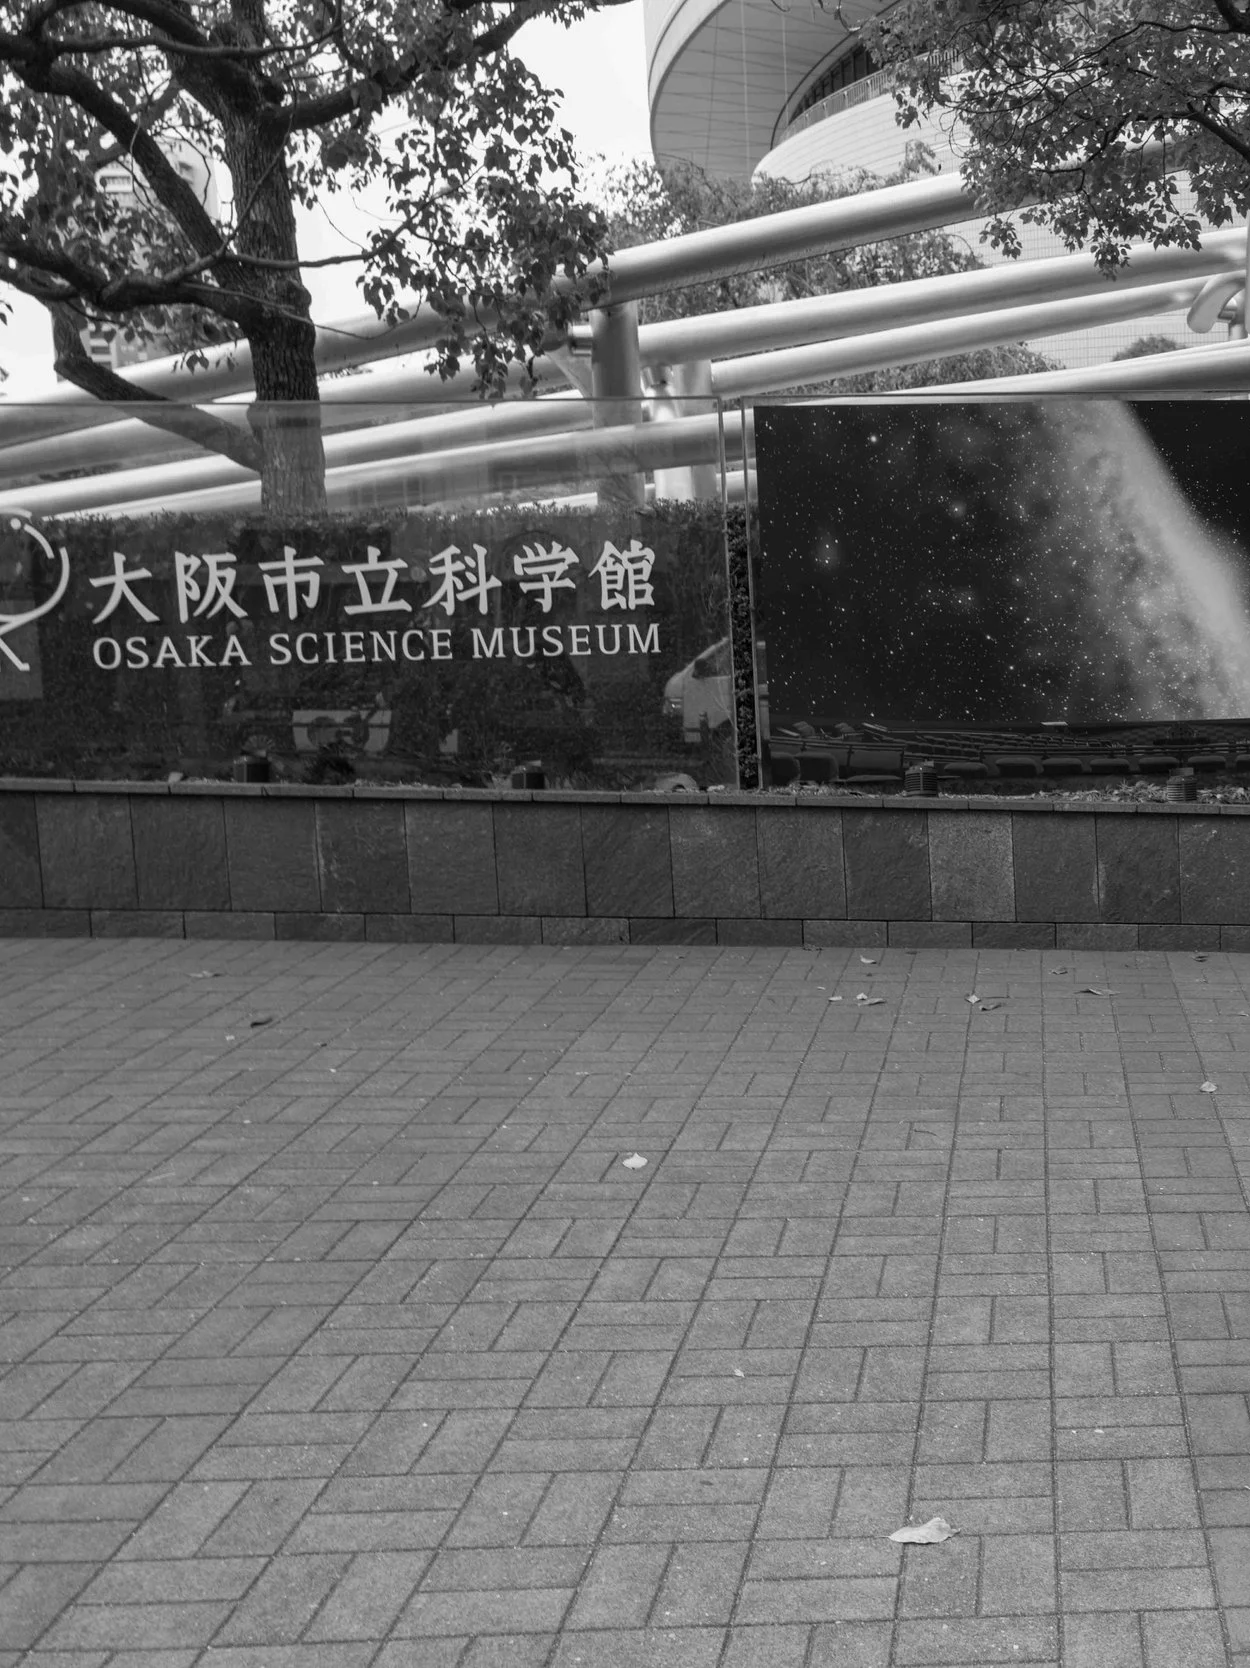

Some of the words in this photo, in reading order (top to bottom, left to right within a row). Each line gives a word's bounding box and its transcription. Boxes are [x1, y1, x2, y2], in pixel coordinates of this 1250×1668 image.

[89, 539, 657, 625] 大阪市立科学館
[93, 633, 252, 671] OSAKA
[270, 626, 454, 666] SCIENCE
[471, 622, 662, 659] MUSEUM
